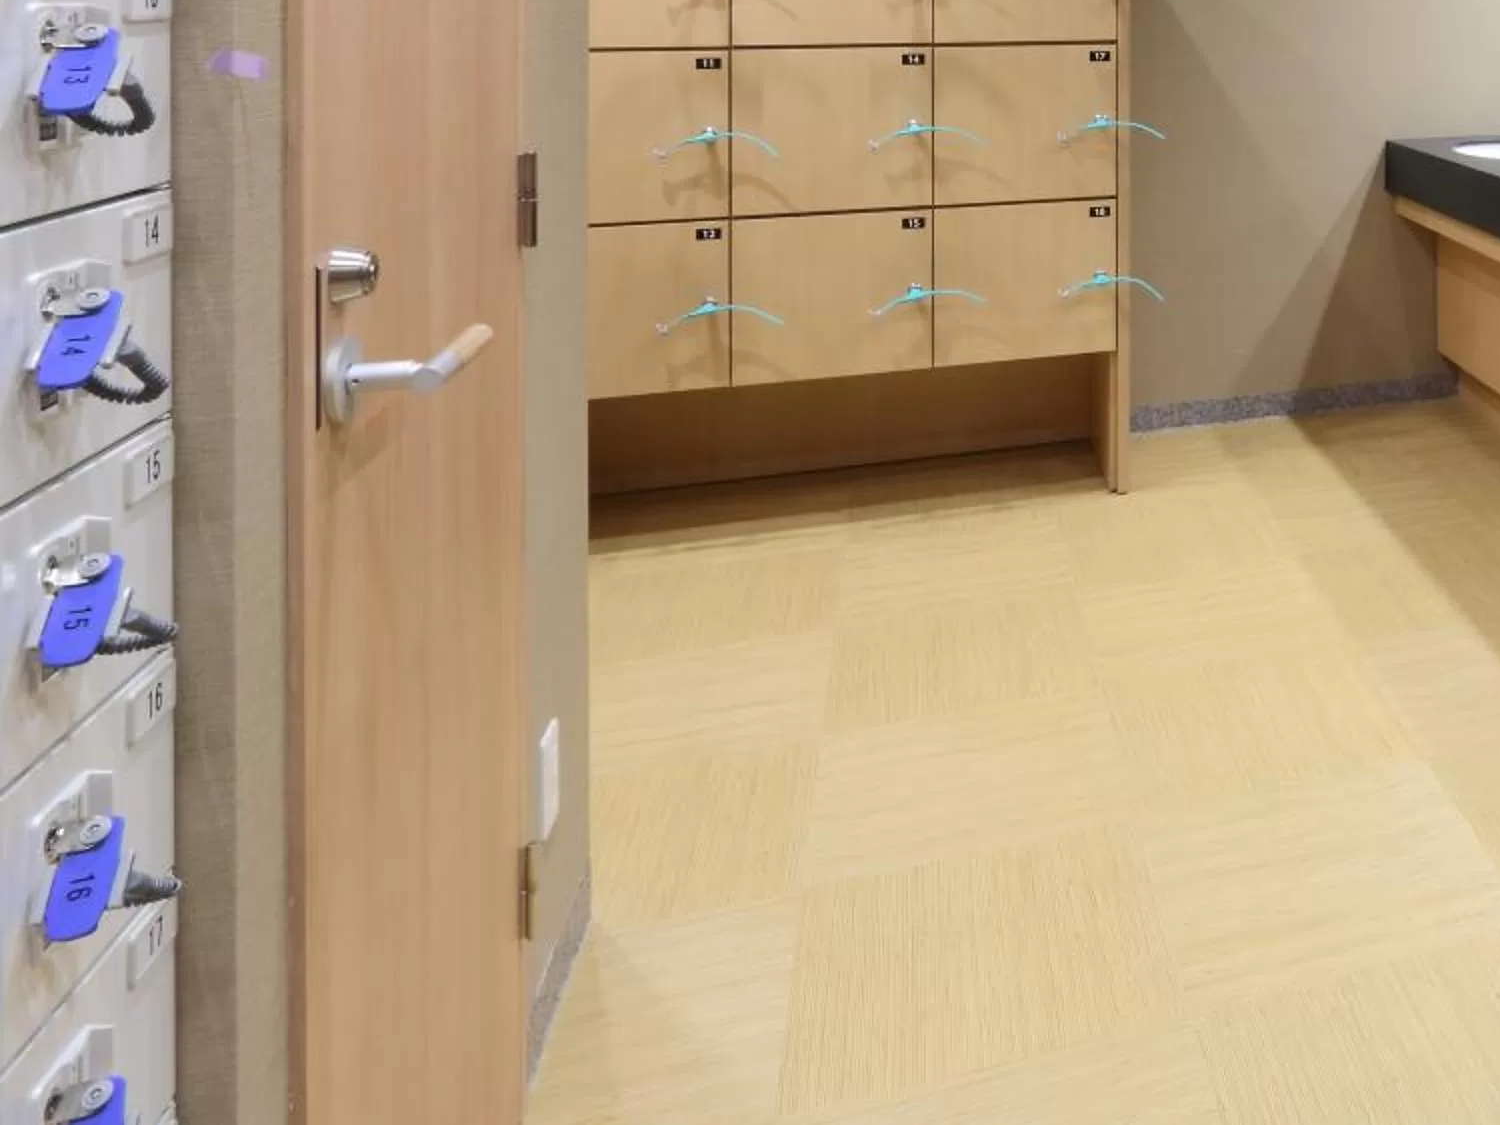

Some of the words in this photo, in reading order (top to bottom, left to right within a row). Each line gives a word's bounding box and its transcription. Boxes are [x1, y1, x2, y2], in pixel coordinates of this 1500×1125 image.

[64, 66, 92, 84] 13
[144, 215, 159, 247] 14
[61, 335, 92, 355] 14
[146, 450, 161, 483] 15
[64, 606, 92, 630] 15
[148, 682, 163, 719] 16
[67, 874, 95, 902] 16
